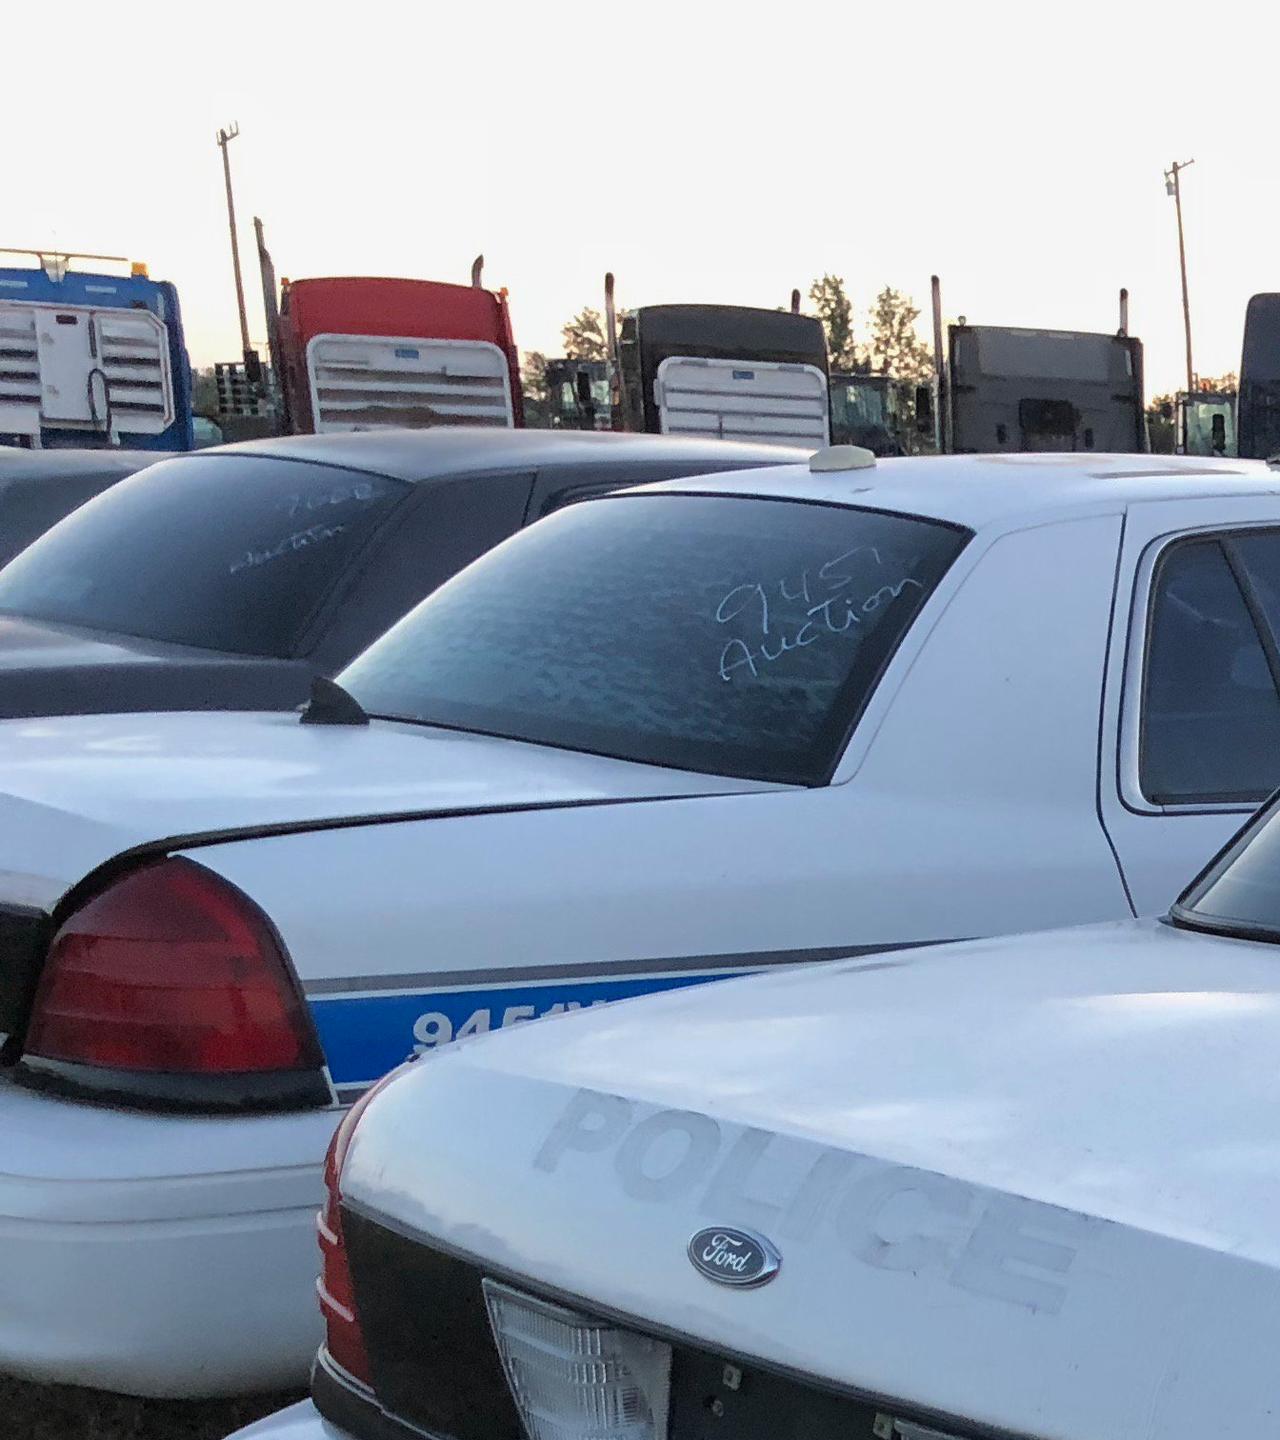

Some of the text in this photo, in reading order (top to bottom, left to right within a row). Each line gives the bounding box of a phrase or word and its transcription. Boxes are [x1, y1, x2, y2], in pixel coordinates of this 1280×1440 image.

[718, 577, 922, 681] Auction
[533, 1087, 1077, 1316] POLICE
[702, 1233, 752, 1273] Ford
